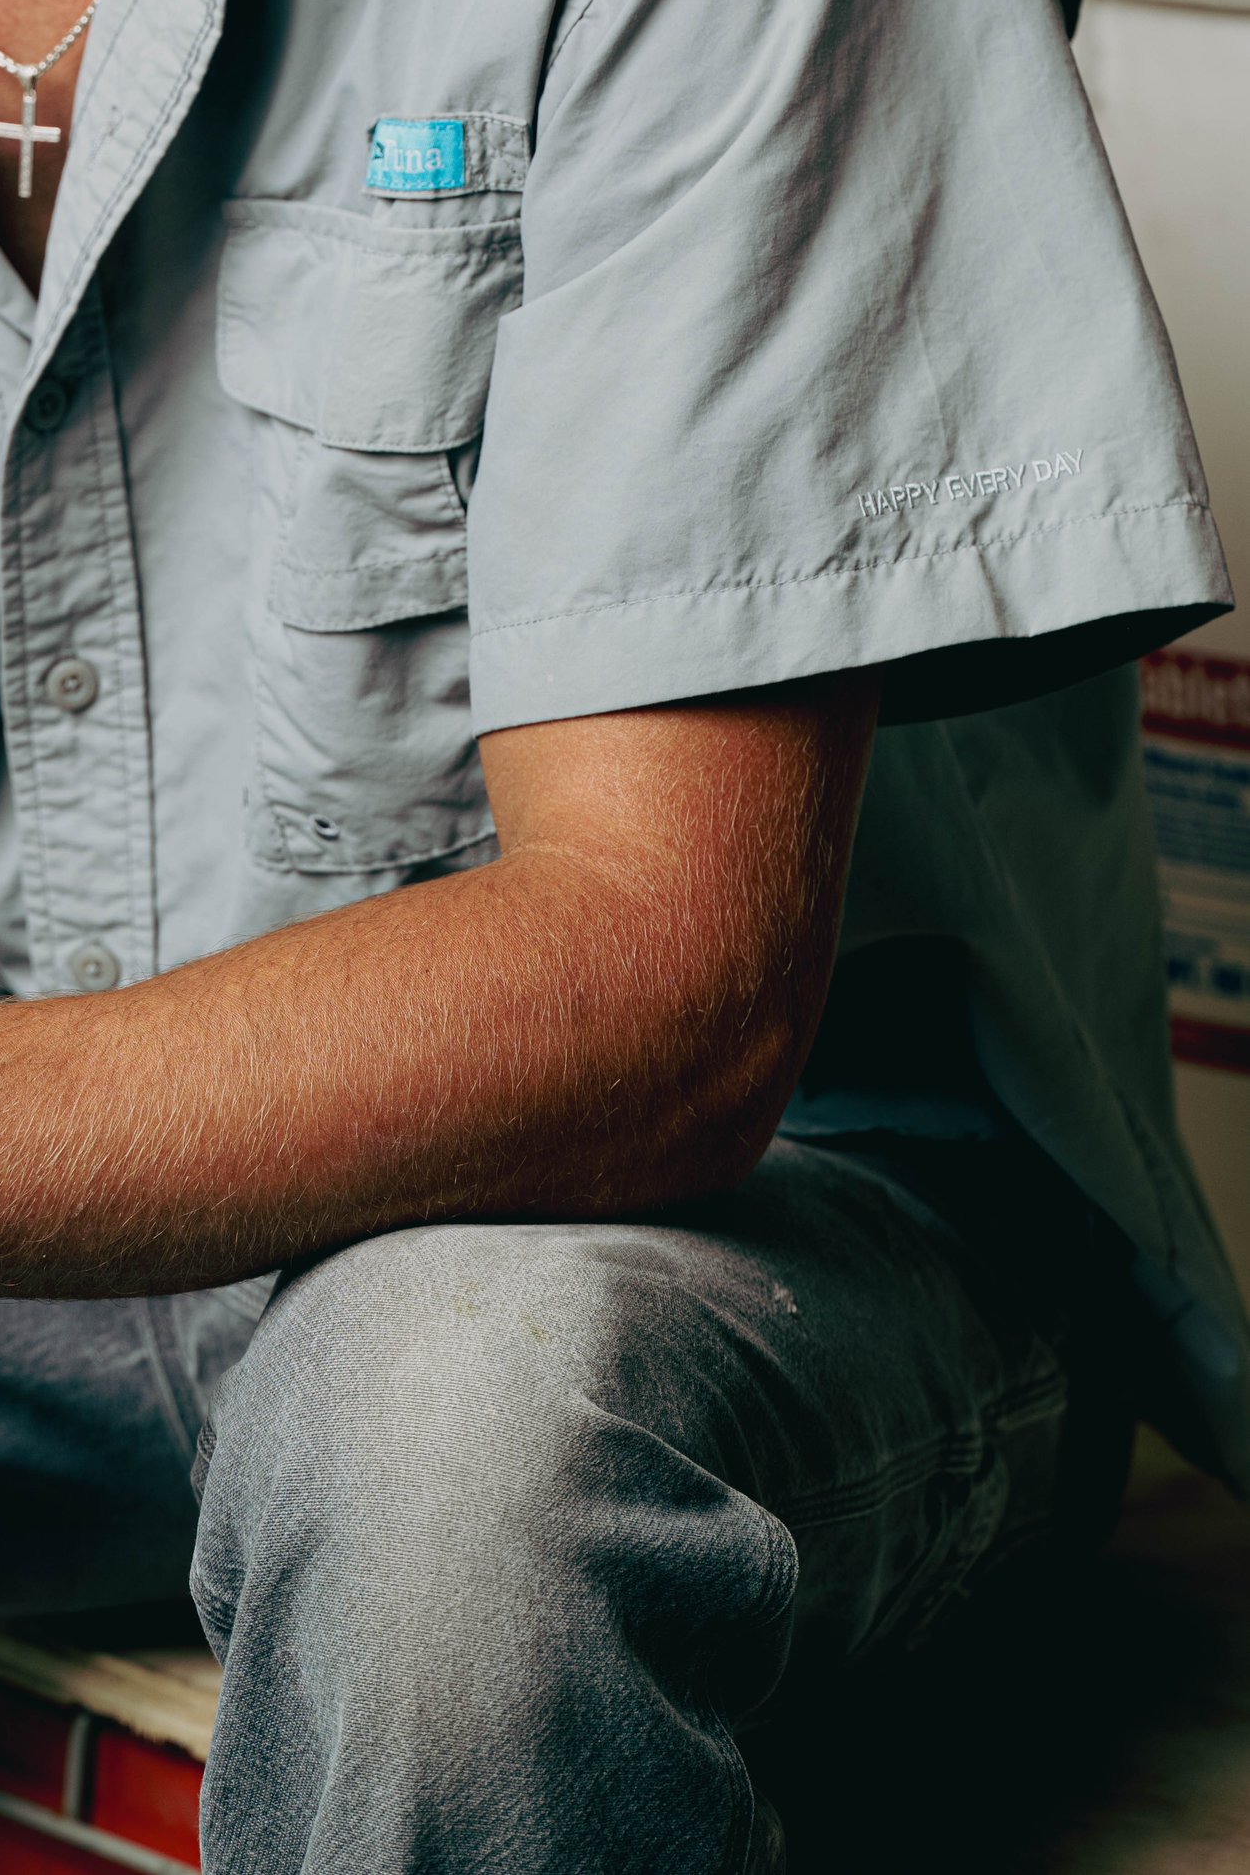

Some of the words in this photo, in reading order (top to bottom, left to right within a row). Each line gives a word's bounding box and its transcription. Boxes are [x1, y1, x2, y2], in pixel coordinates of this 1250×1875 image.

[856, 479, 940, 518] HAPPY
[944, 463, 1027, 500] EVERY
[1031, 447, 1085, 483] DAY
